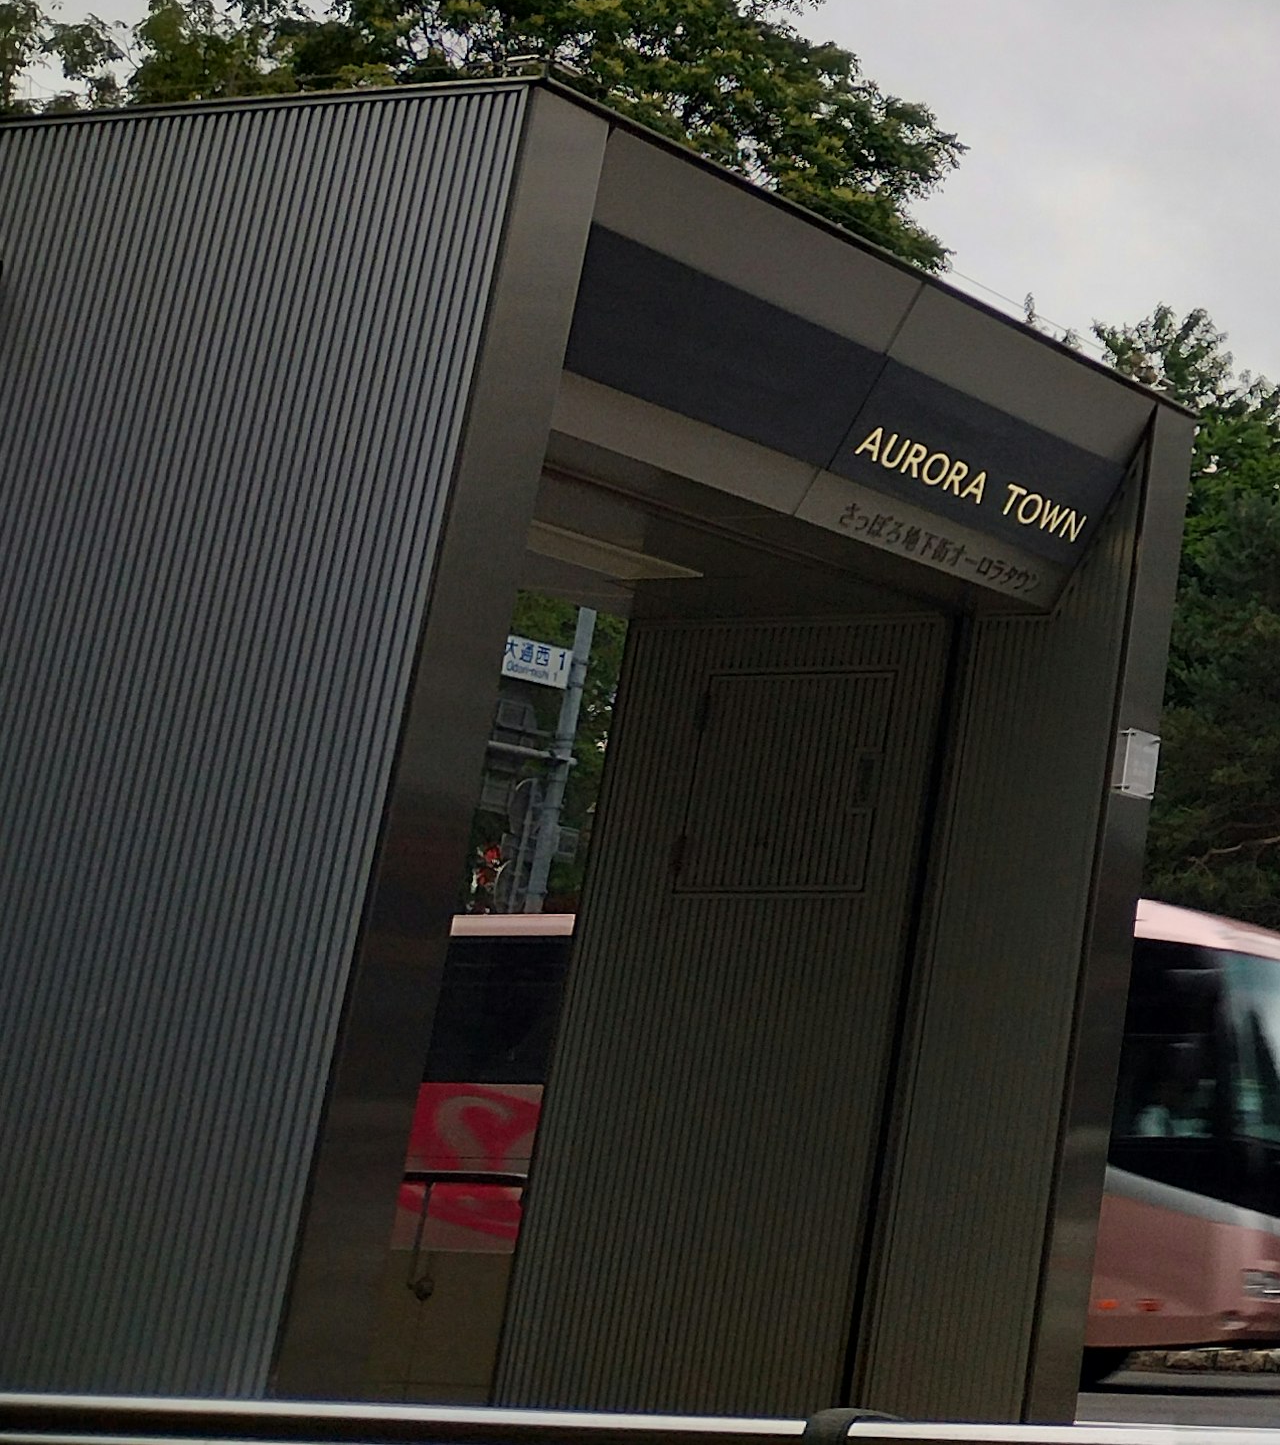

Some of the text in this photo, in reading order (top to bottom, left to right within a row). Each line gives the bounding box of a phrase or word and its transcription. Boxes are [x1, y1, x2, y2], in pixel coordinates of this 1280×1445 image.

[854, 426, 1087, 543] AURORA TOWN
[838, 502, 1041, 593] さっぽろ地下街オーロラタウン
